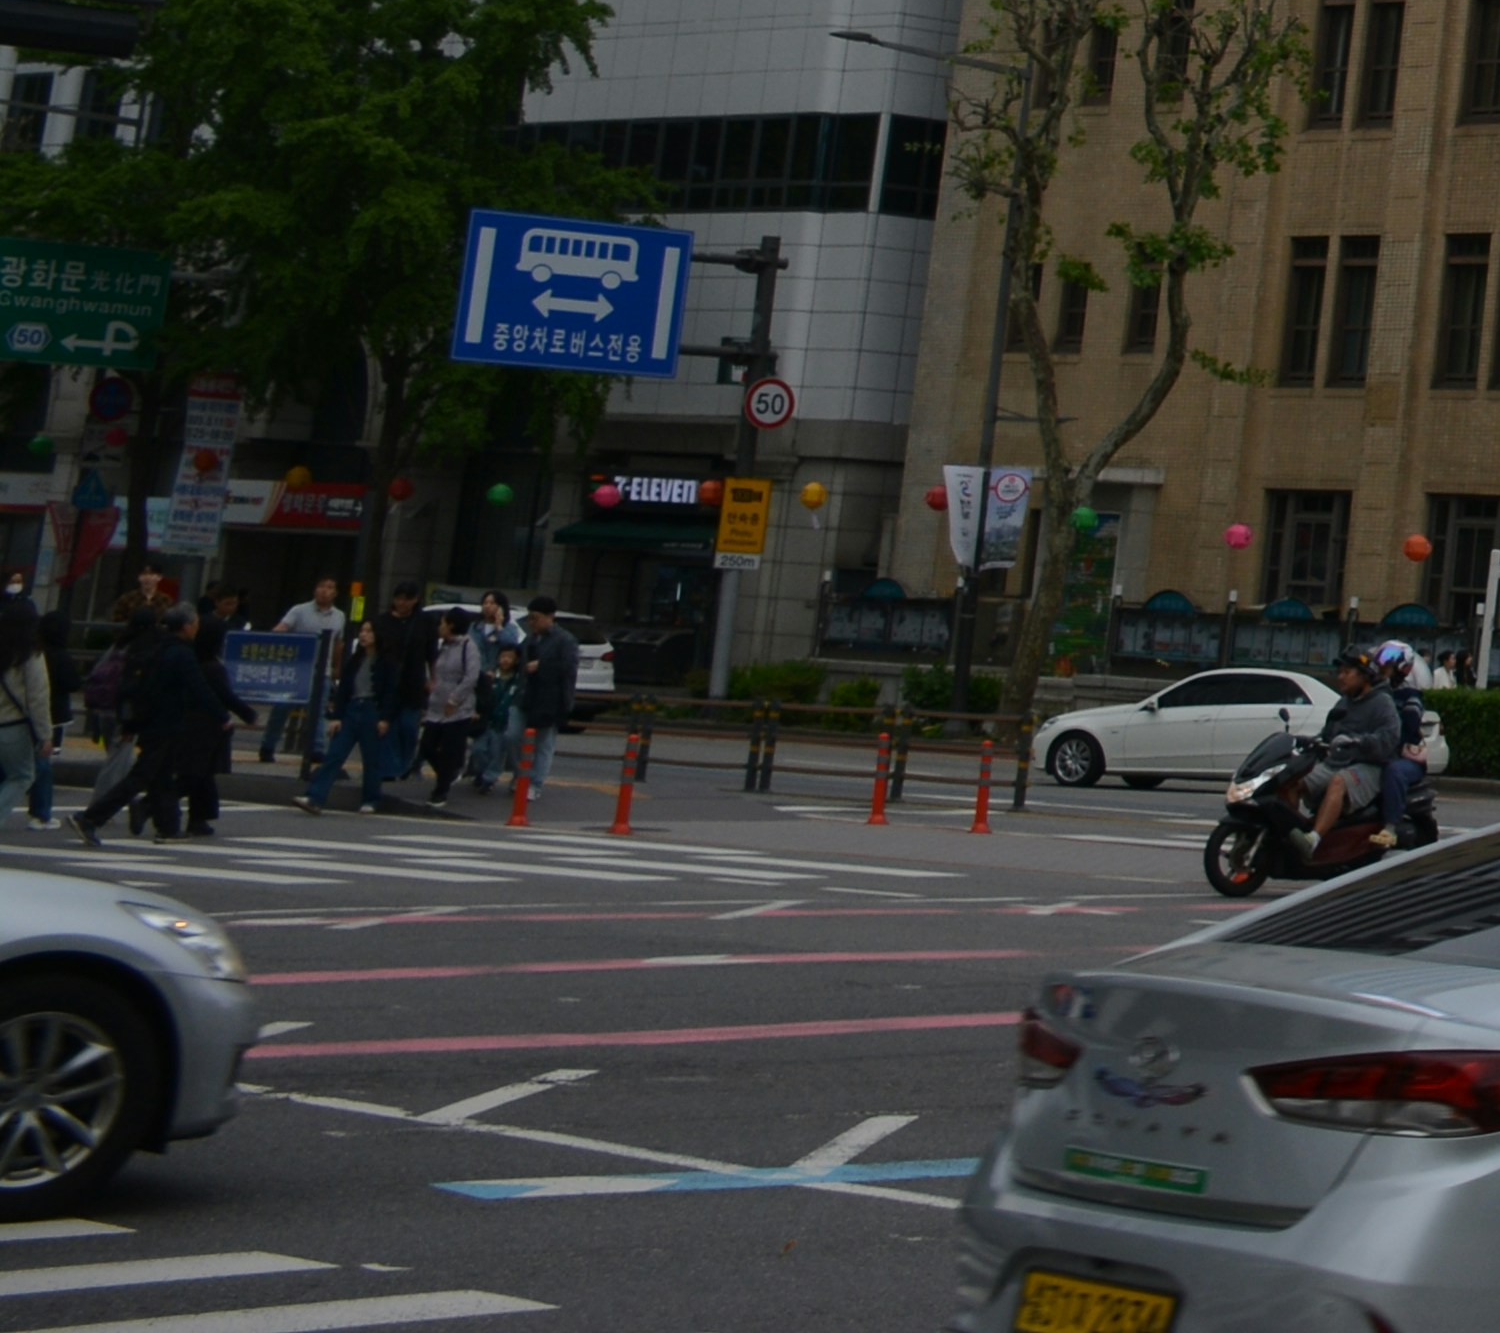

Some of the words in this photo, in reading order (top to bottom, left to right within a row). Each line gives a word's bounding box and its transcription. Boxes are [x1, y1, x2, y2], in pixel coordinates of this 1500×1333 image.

[1, 255, 87, 293] 광화문
[0, 290, 153, 317] Gwanghwamun
[17, 328, 43, 346] 50
[756, 393, 785, 415] 50
[720, 555, 755, 567] 250m
